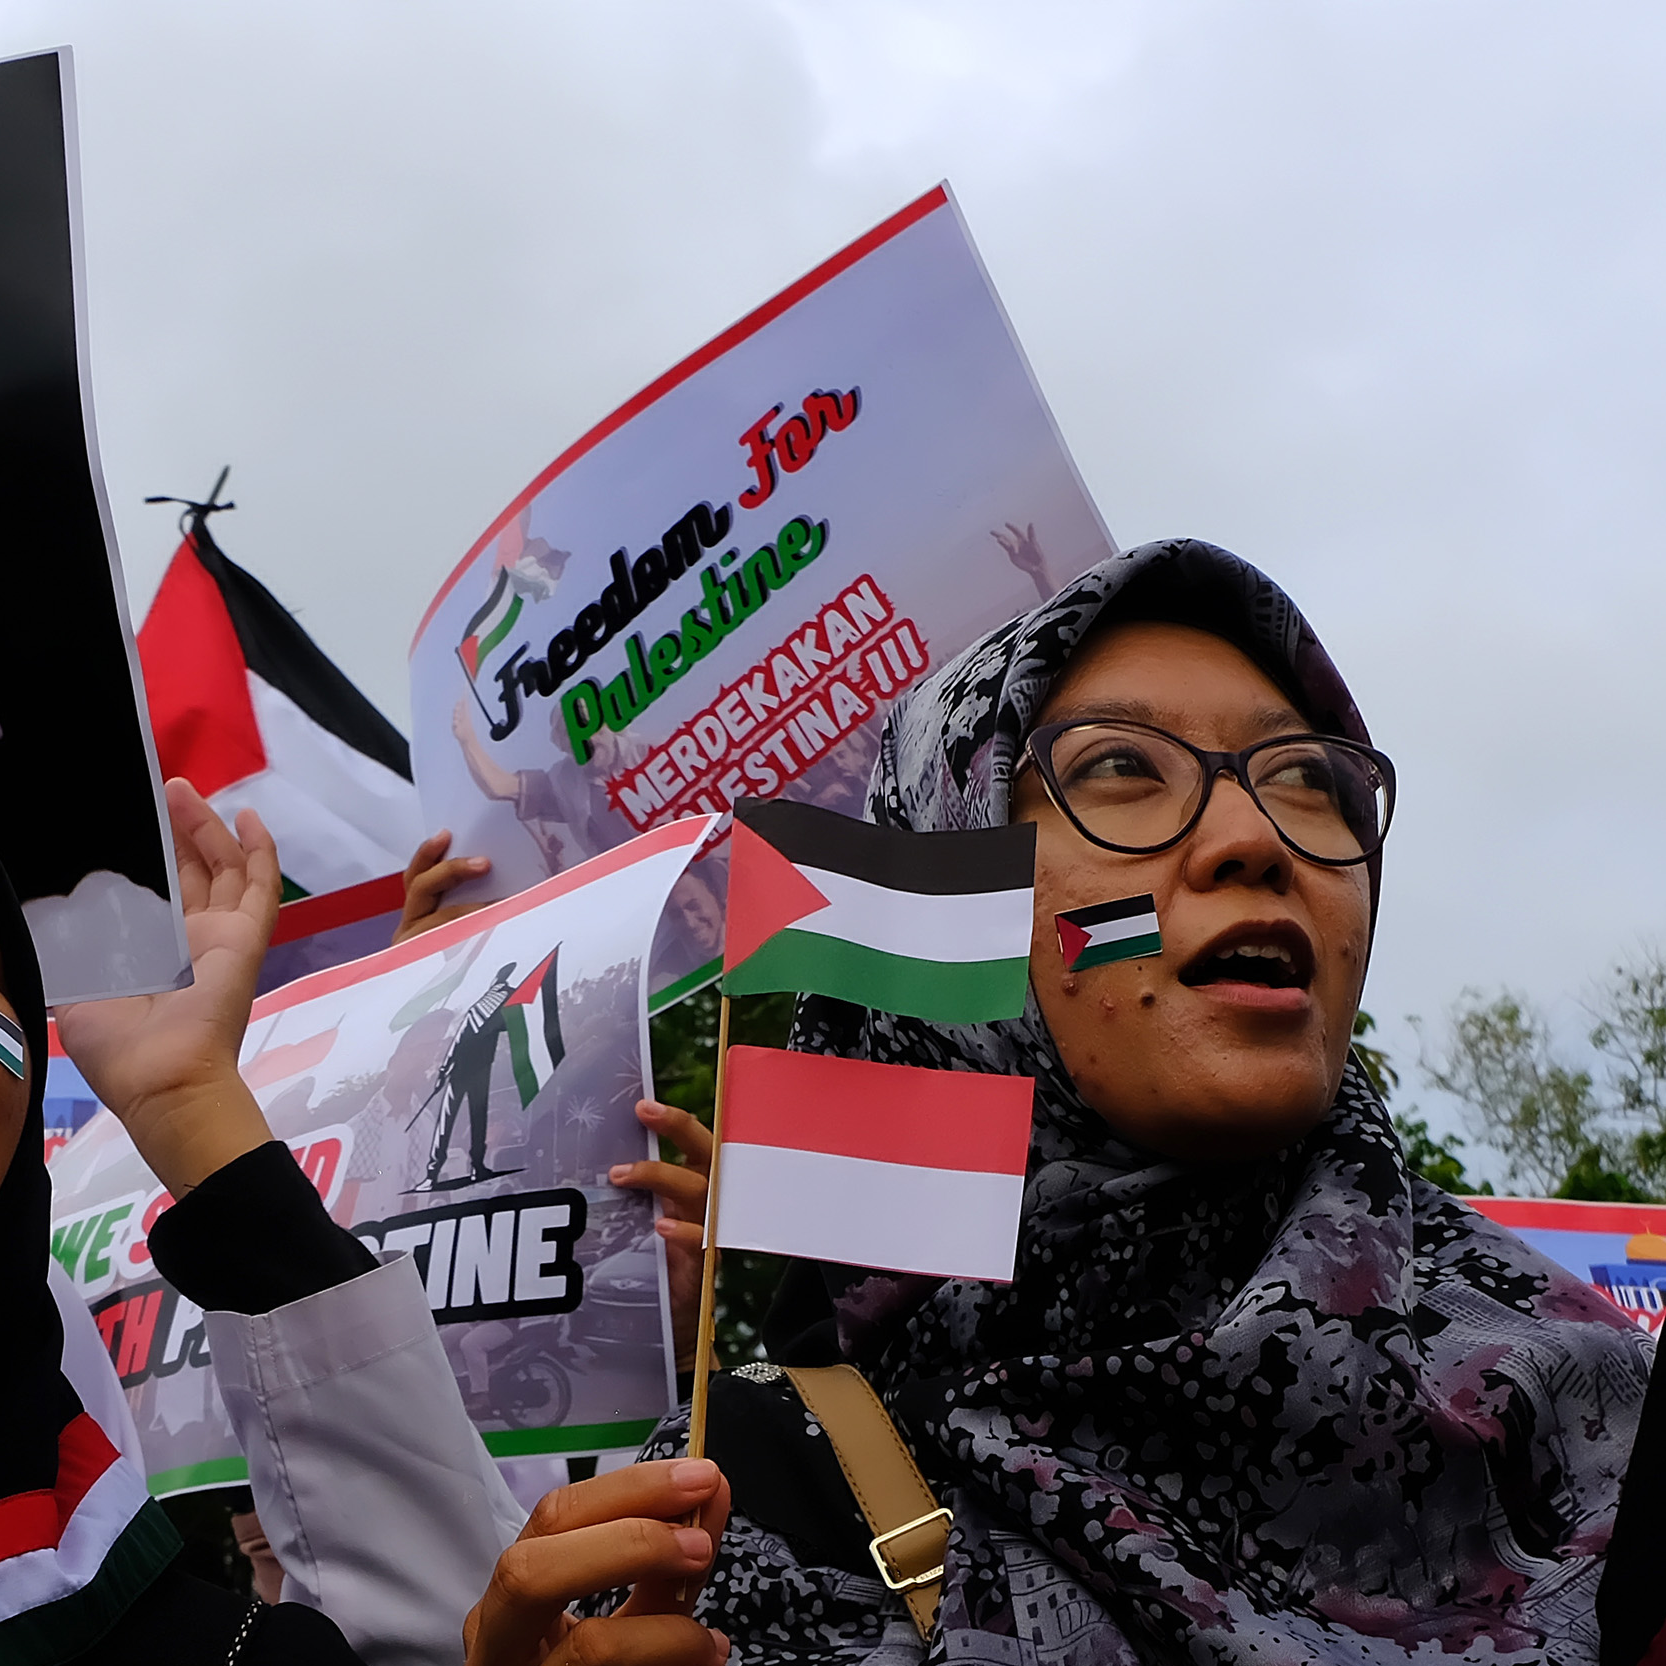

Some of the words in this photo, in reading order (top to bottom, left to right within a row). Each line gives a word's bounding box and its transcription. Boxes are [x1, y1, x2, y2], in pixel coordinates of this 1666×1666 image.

[490, 500, 731, 742] Freedom
[739, 386, 861, 509] For
[559, 514, 830, 766] Palestine
[617, 581, 887, 824] MERDEKAKAN
[680, 682, 868, 850] LESTINA
[52, 1203, 135, 1284] WE
